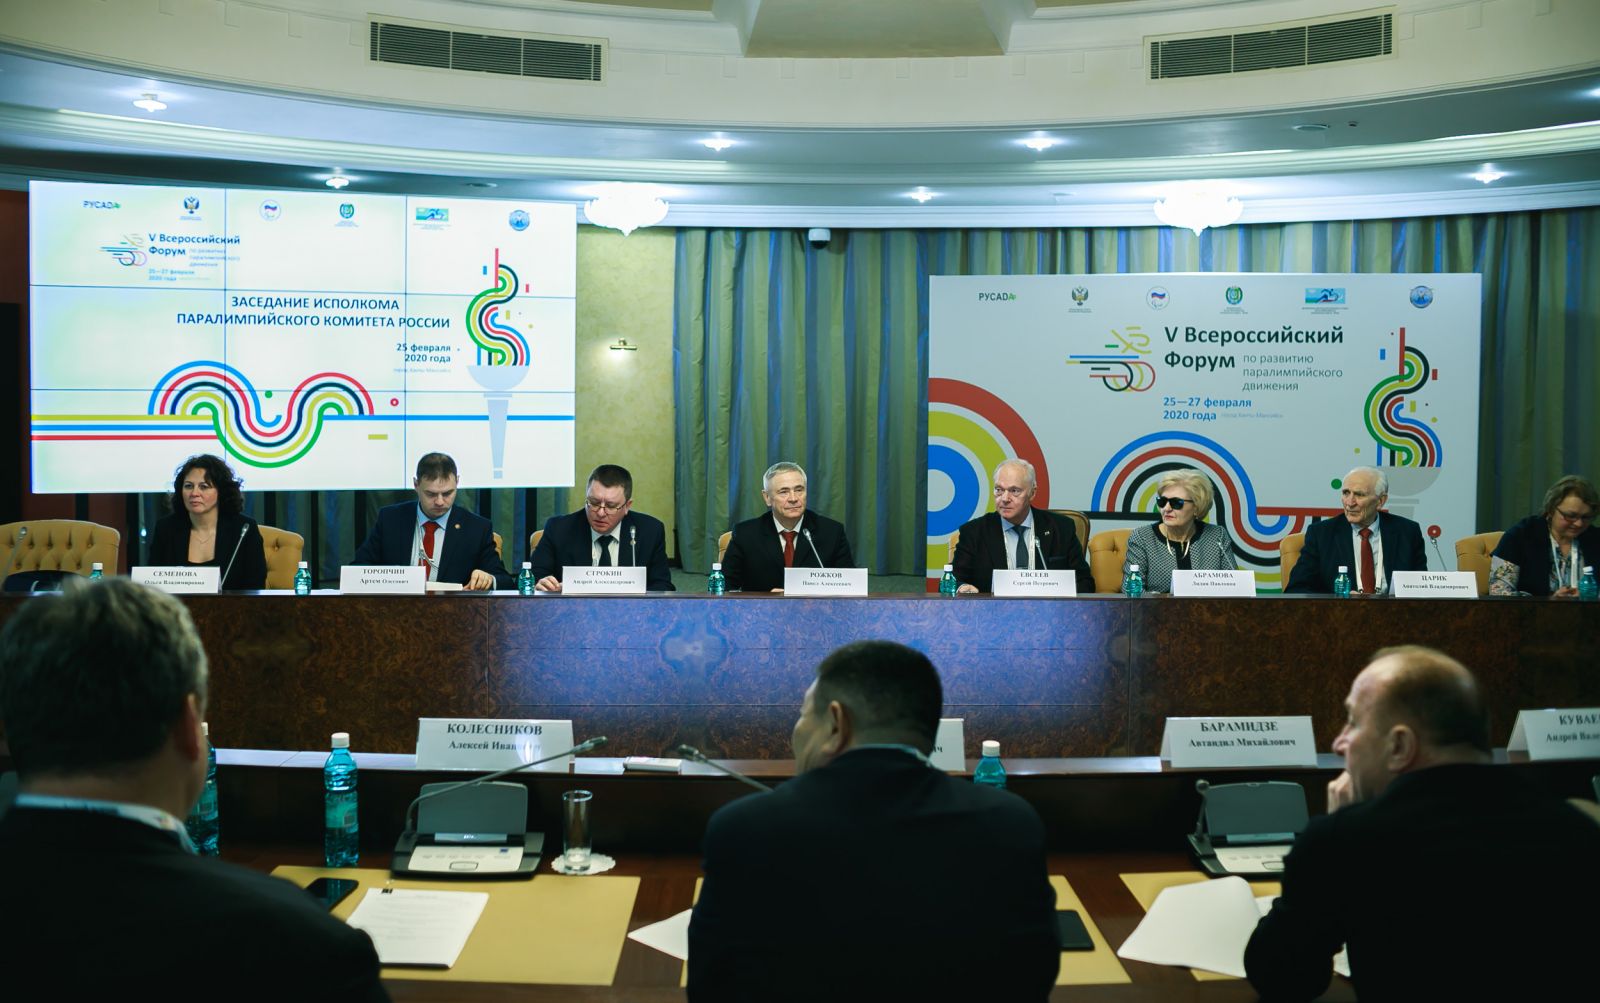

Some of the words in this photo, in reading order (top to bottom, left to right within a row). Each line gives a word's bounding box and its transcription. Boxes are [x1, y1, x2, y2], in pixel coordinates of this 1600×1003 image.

[149, 233, 156, 242] V
[160, 233, 240, 244] Всероссийский
[149, 246, 186, 256] Форум
[231, 296, 310, 310] ЗАСЕДАНИЕ
[314, 298, 400, 310] ИСПОЛКОМА
[177, 312, 320, 327] ПАРАЛИМПИЙСКОГО
[323, 316, 395, 328] КОМИТЕТА
[398, 317, 450, 328] РОССИИ
[1164, 326, 1179, 343] V
[1185, 325, 1344, 347] Всероссийский
[396, 343, 408, 352] 25
[410, 343, 451, 353] февраля
[405, 354, 427, 362] 2020
[429, 355, 451, 364] года
[1164, 351, 1235, 373] Форум
[1243, 355, 1257, 363] по
[1260, 355, 1314, 364] развитию
[1243, 367, 1344, 378] паралимпийского
[1242, 382, 1299, 392] движения
[1203, 397, 1252, 408] февраля
[1163, 411, 1189, 420] 2020
[1192, 412, 1217, 422] года
[447, 723, 543, 736] КОЛЕСНИКОВ
[1200, 721, 1279, 733] БАРАМИДЗЕ
[449, 740, 489, 750] Алексей
[1189, 738, 1235, 748] Автандил
[1236, 738, 1297, 748] Михайлович
